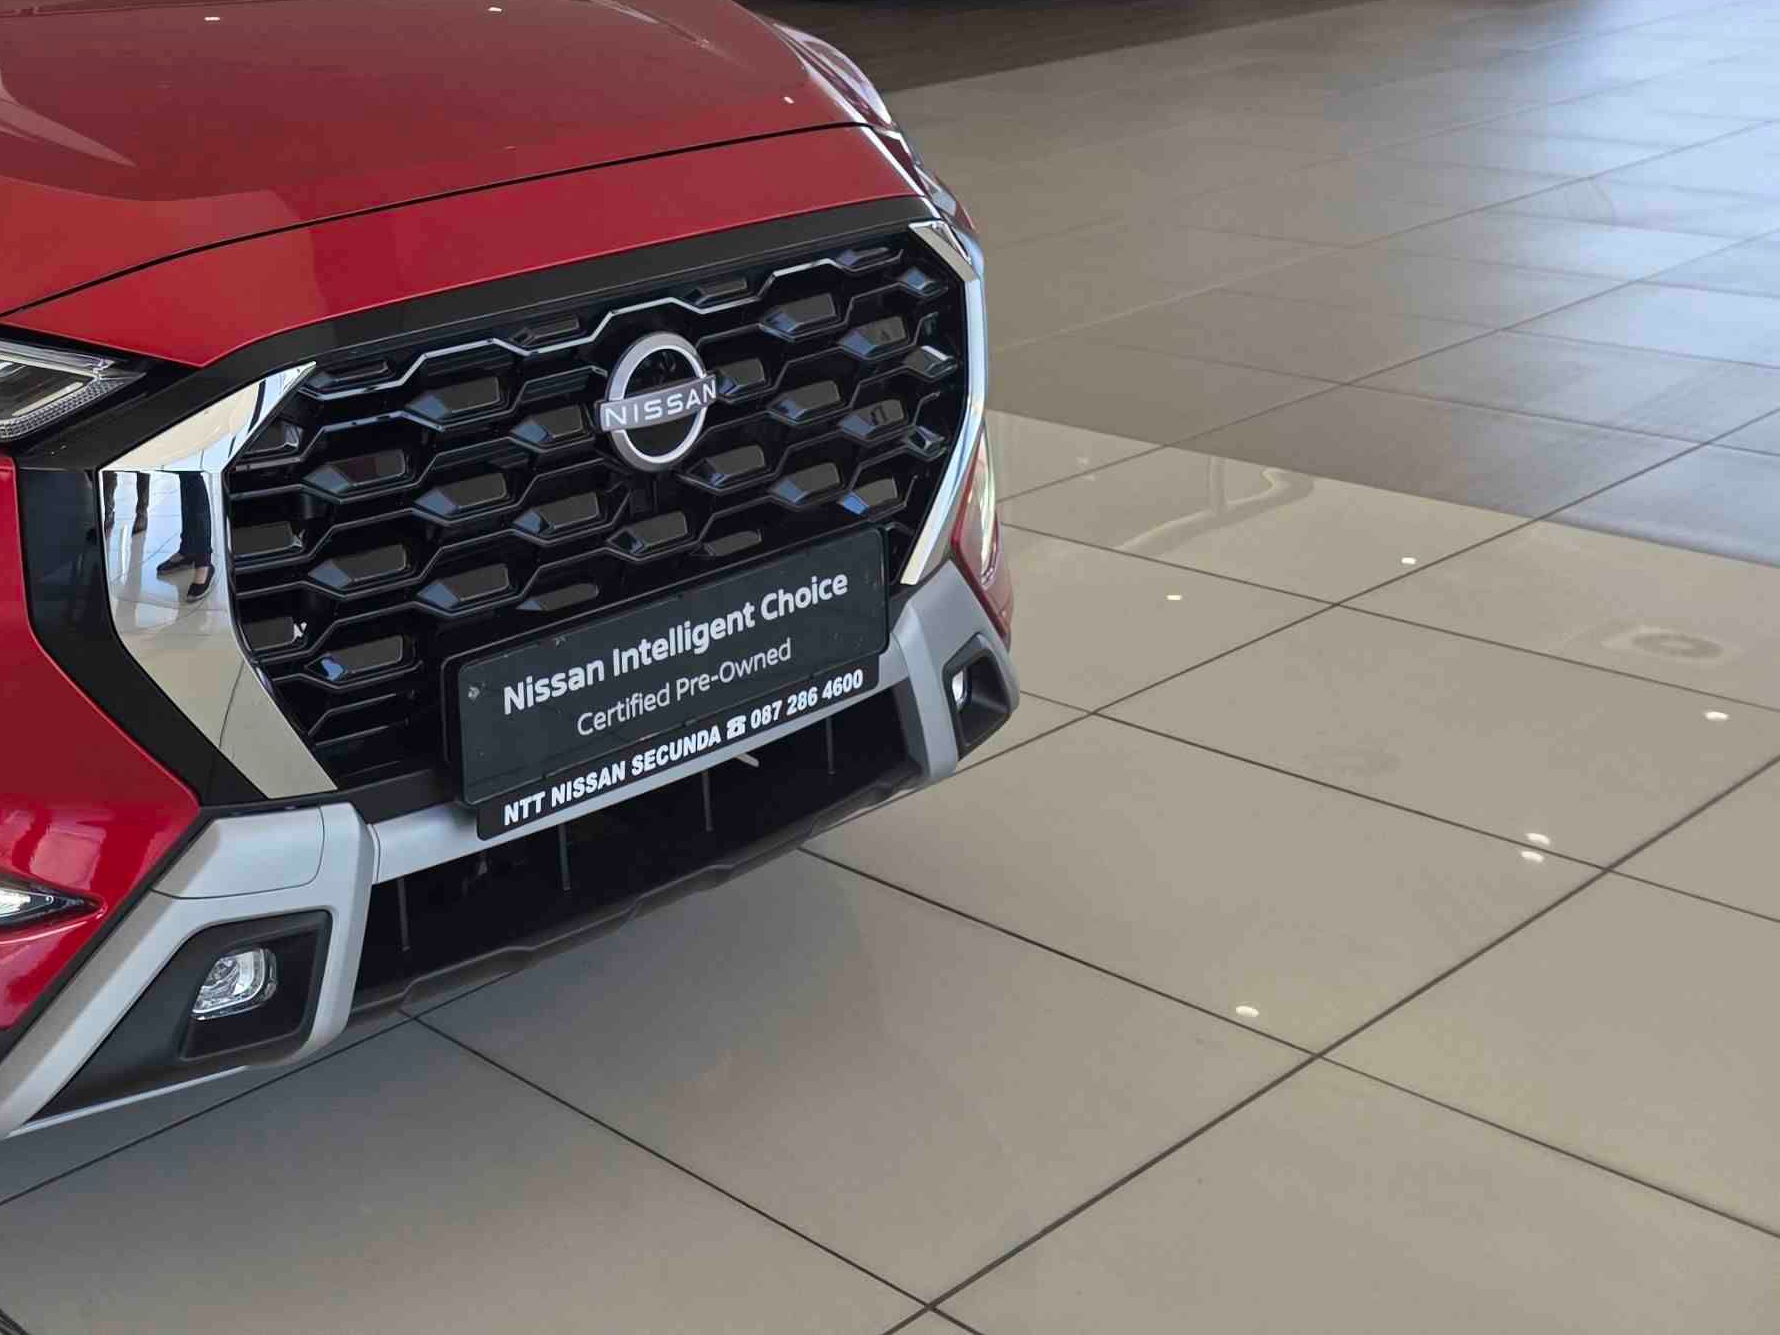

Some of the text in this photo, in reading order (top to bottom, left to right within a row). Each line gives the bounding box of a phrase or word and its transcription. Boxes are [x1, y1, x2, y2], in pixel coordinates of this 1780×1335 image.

[603, 379, 717, 427] NISSAN
[503, 571, 849, 715] Nissan Intelligent Choice
[577, 638, 793, 737] Certified Pre-Owned
[503, 668, 864, 826] NTT NISSAN SECUNDA 087 286 4600
